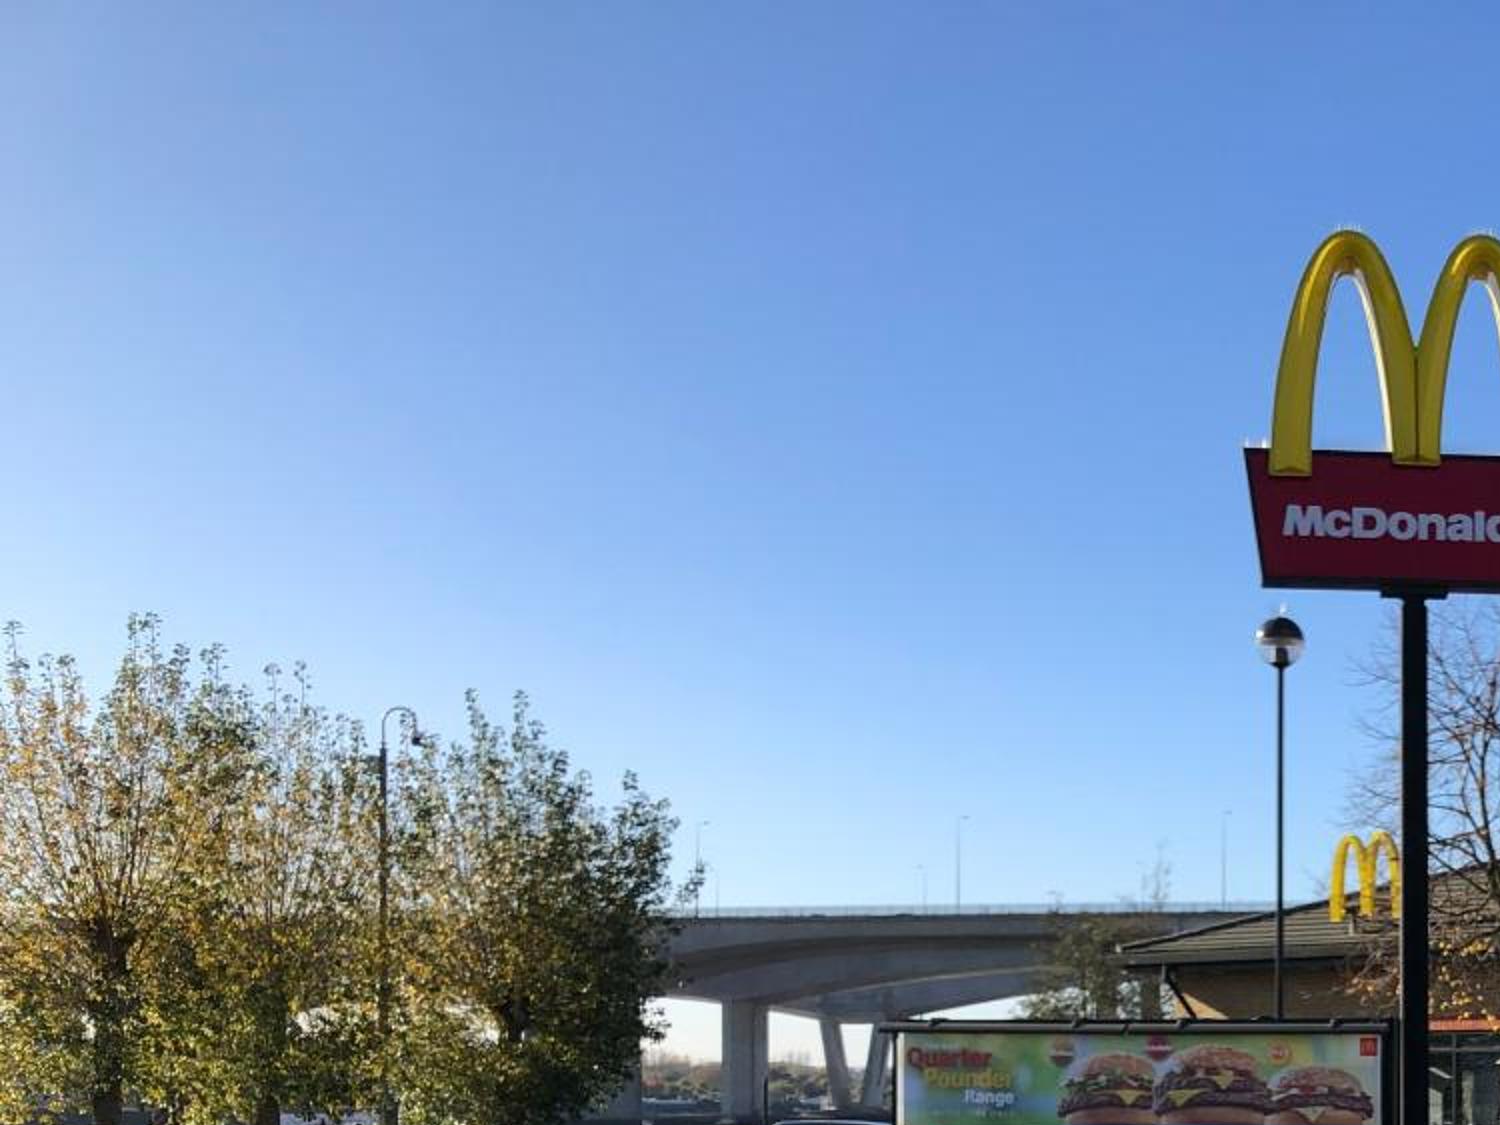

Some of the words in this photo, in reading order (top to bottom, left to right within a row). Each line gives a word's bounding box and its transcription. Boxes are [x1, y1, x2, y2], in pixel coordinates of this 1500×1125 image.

[908, 1047, 993, 1069] Quarter
[924, 1068, 1011, 1089] Pounder
[964, 1088, 1015, 1108] Range
